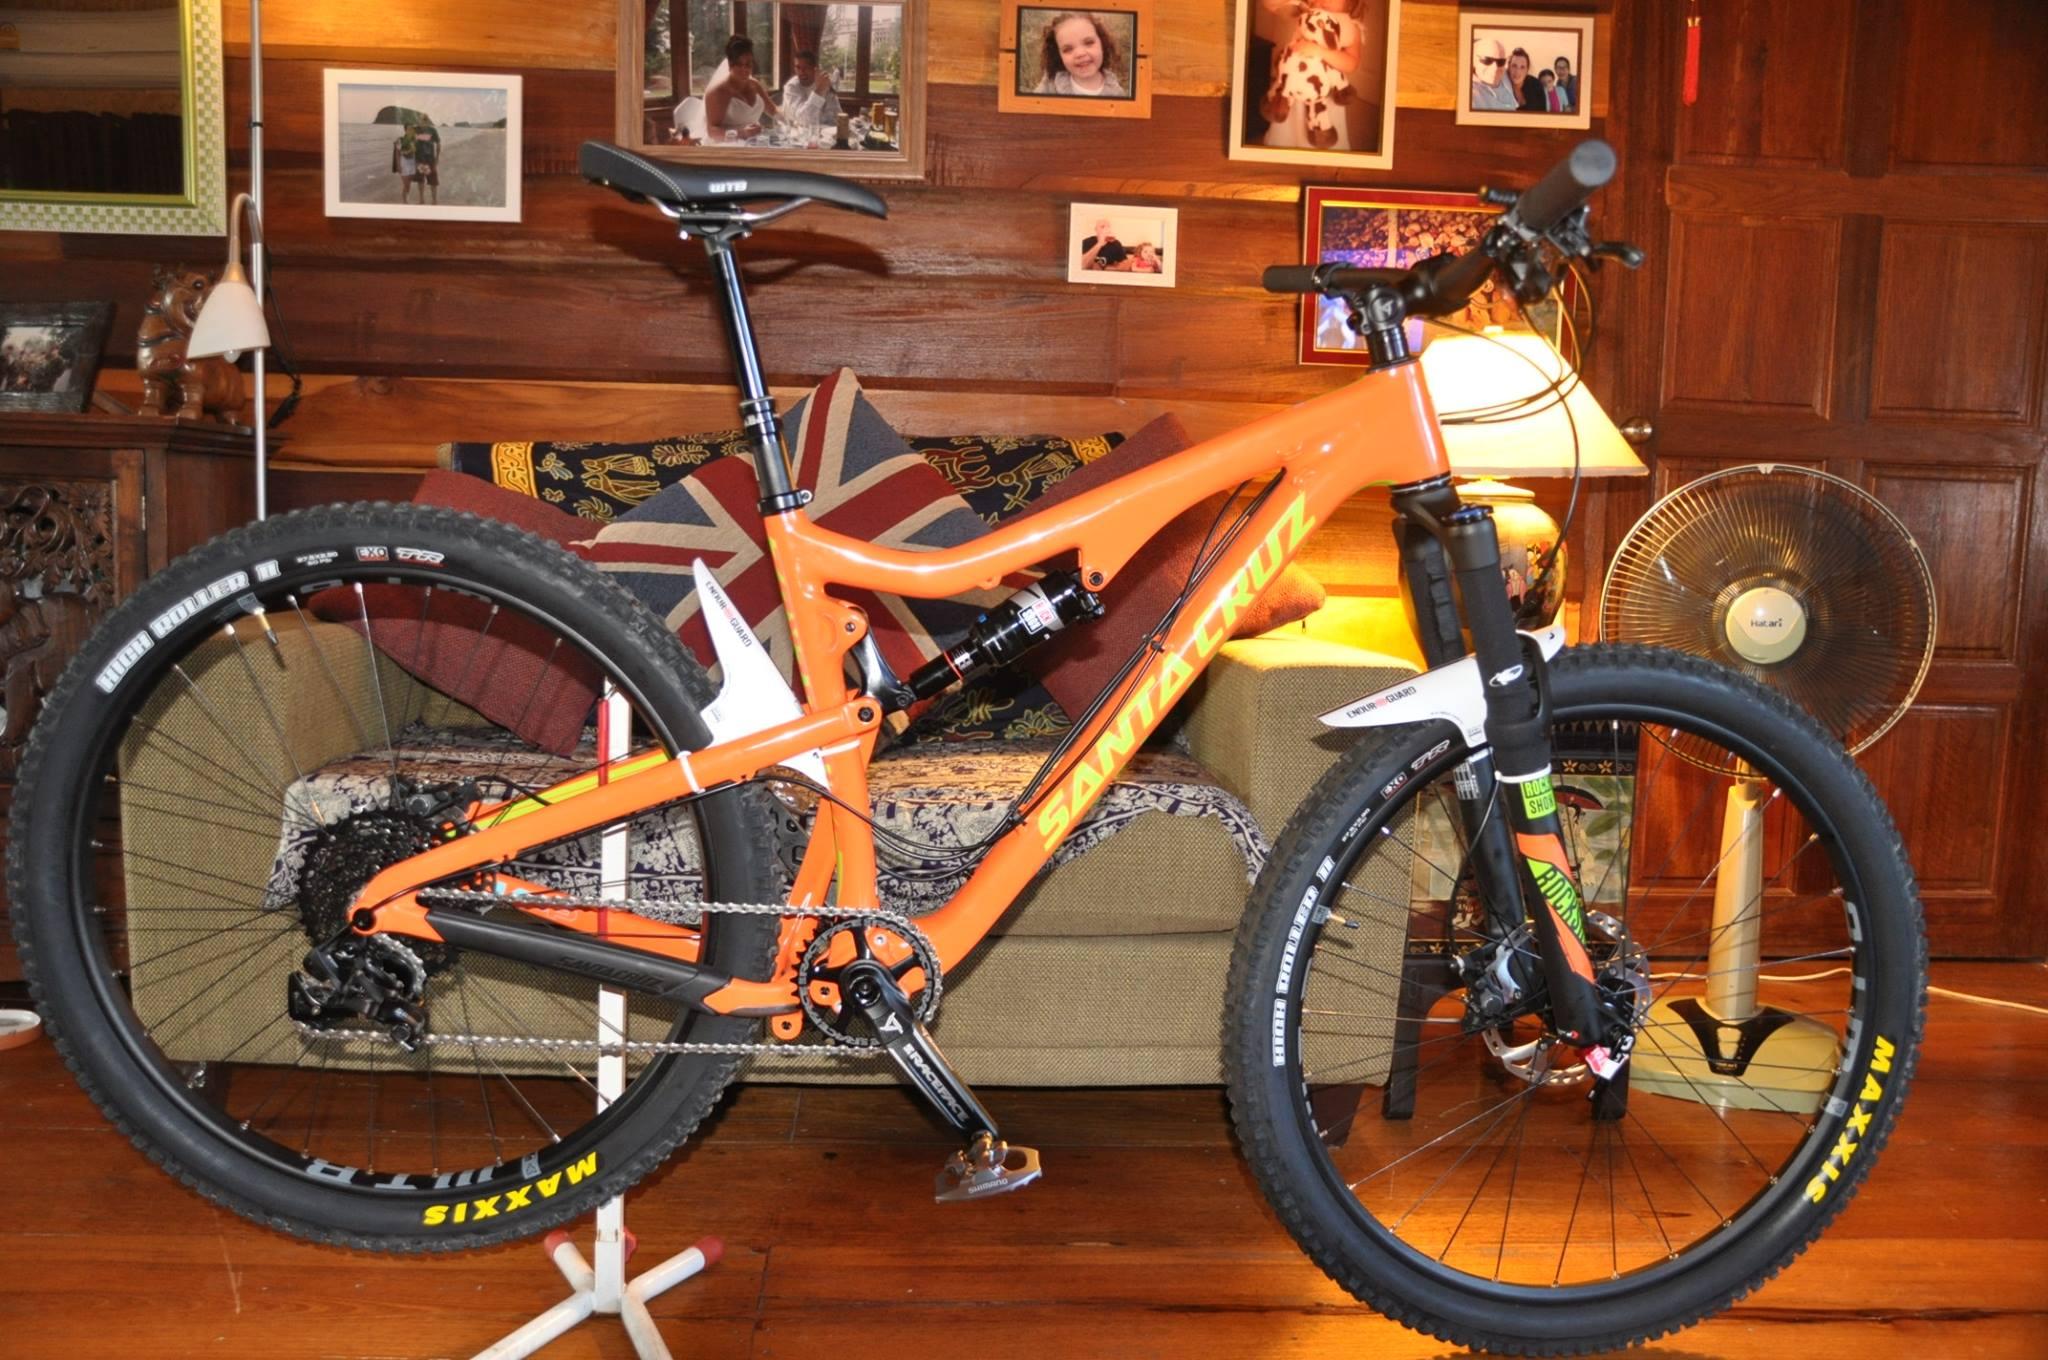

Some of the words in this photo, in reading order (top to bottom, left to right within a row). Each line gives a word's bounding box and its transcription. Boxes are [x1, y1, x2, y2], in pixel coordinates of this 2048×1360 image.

[357, 547, 387, 560] EXO
[95, 629, 155, 693] HIGH
[150, 571, 250, 639] ROLLER
[1750, 618, 1782, 627] Hatari
[1037, 650, 1195, 852] SANTA
[1192, 490, 1317, 660] CRUZ
[1276, 885, 1319, 994] ROLLER
[1272, 998, 1287, 1067] HIGH
[1804, 1034, 1896, 1203] MAXXIS
[421, 1151, 598, 1226] MAXXIS
[967, 1177, 1009, 1194] SHIMANO
